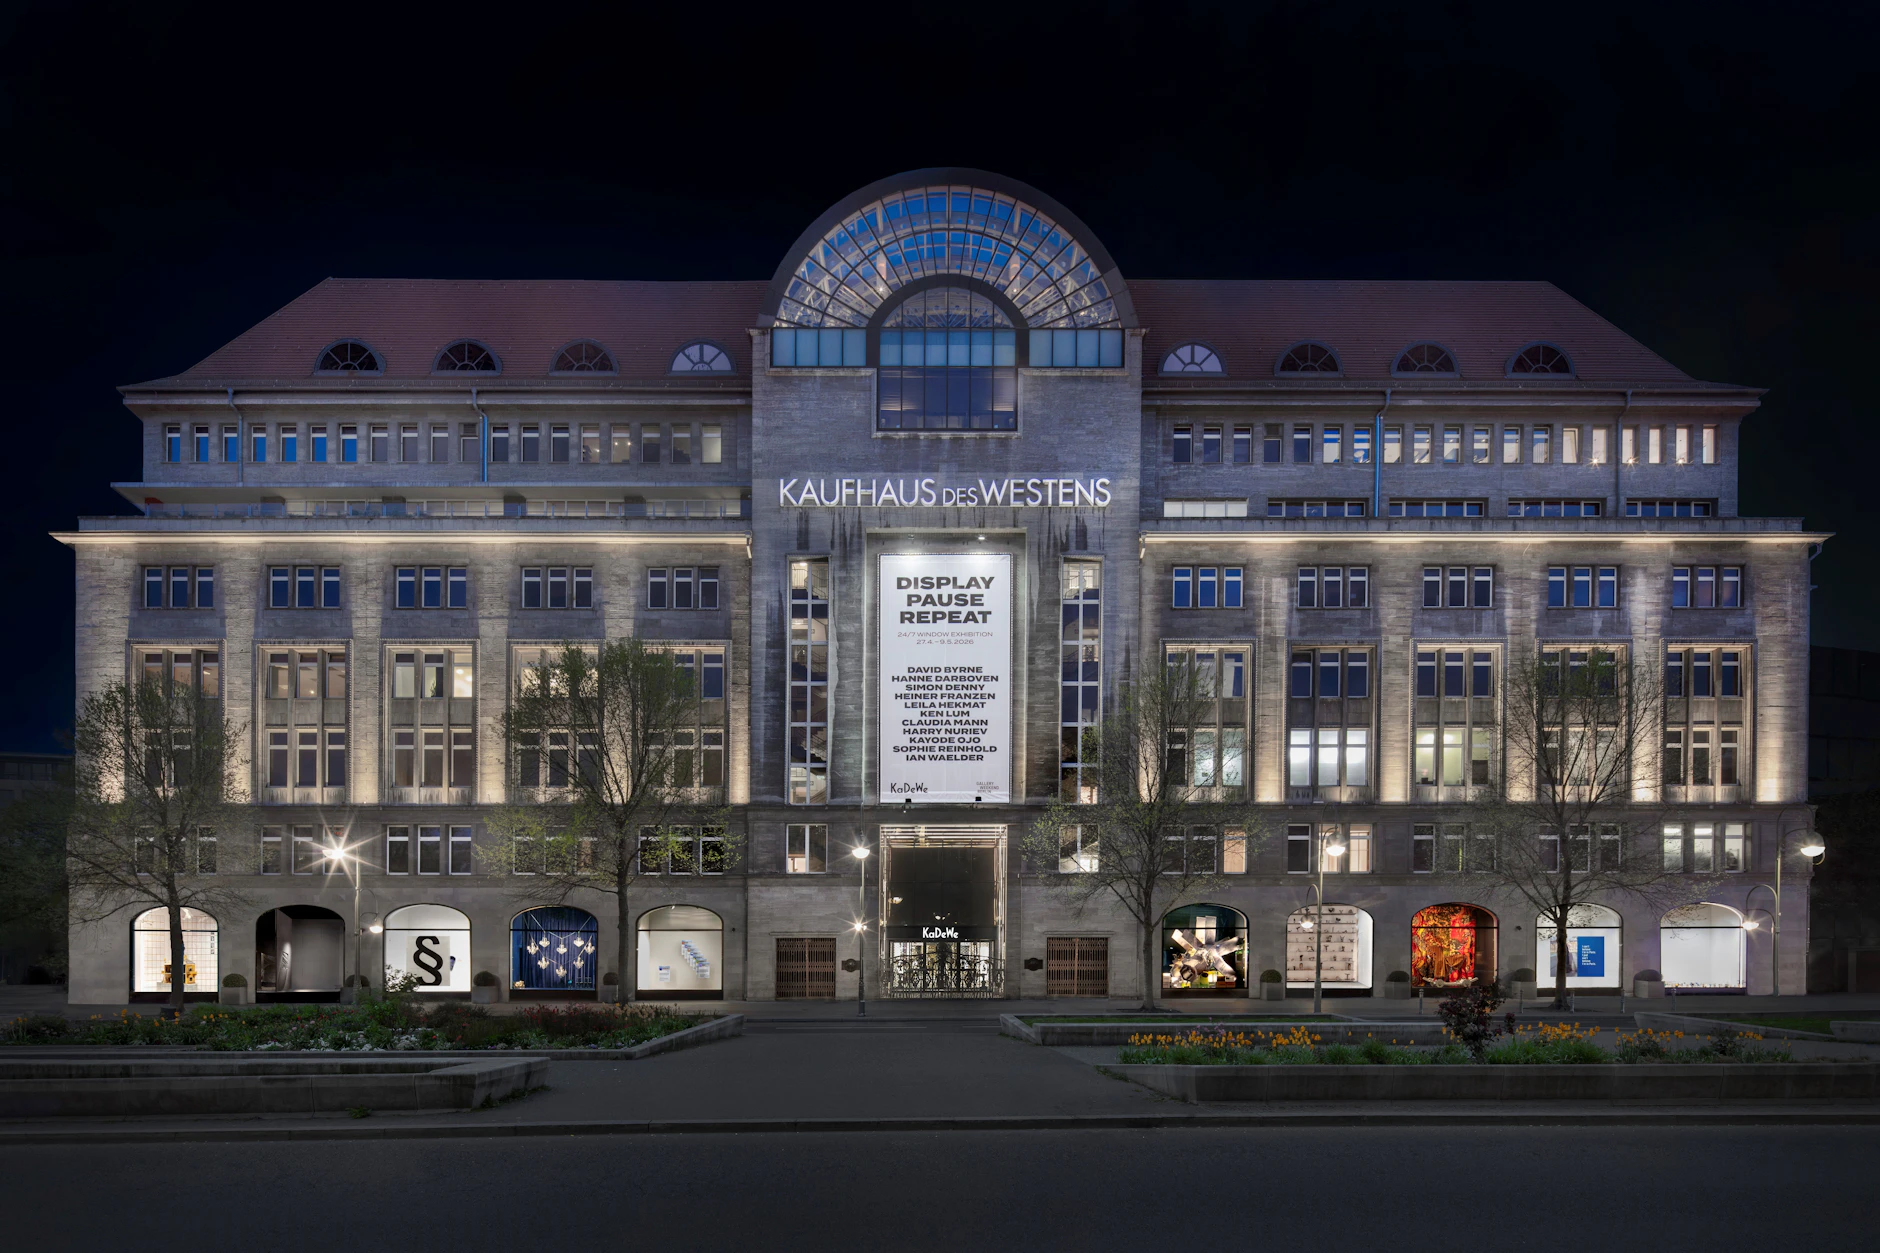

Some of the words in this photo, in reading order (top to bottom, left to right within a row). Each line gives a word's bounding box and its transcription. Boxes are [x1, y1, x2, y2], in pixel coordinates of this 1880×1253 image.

[780, 478, 937, 507] KAUFHAUS
[942, 487, 977, 507] DES
[976, 478, 1112, 507] WESTENS
[896, 576, 995, 590] DISPLAY
[906, 593, 985, 607] PAUSE
[899, 610, 993, 624] REPEAT
[907, 666, 942, 674] DAVID
[944, 666, 983, 674] BYRNE
[890, 782, 929, 794] KaDeWe
[922, 927, 959, 939] KaDeWe
